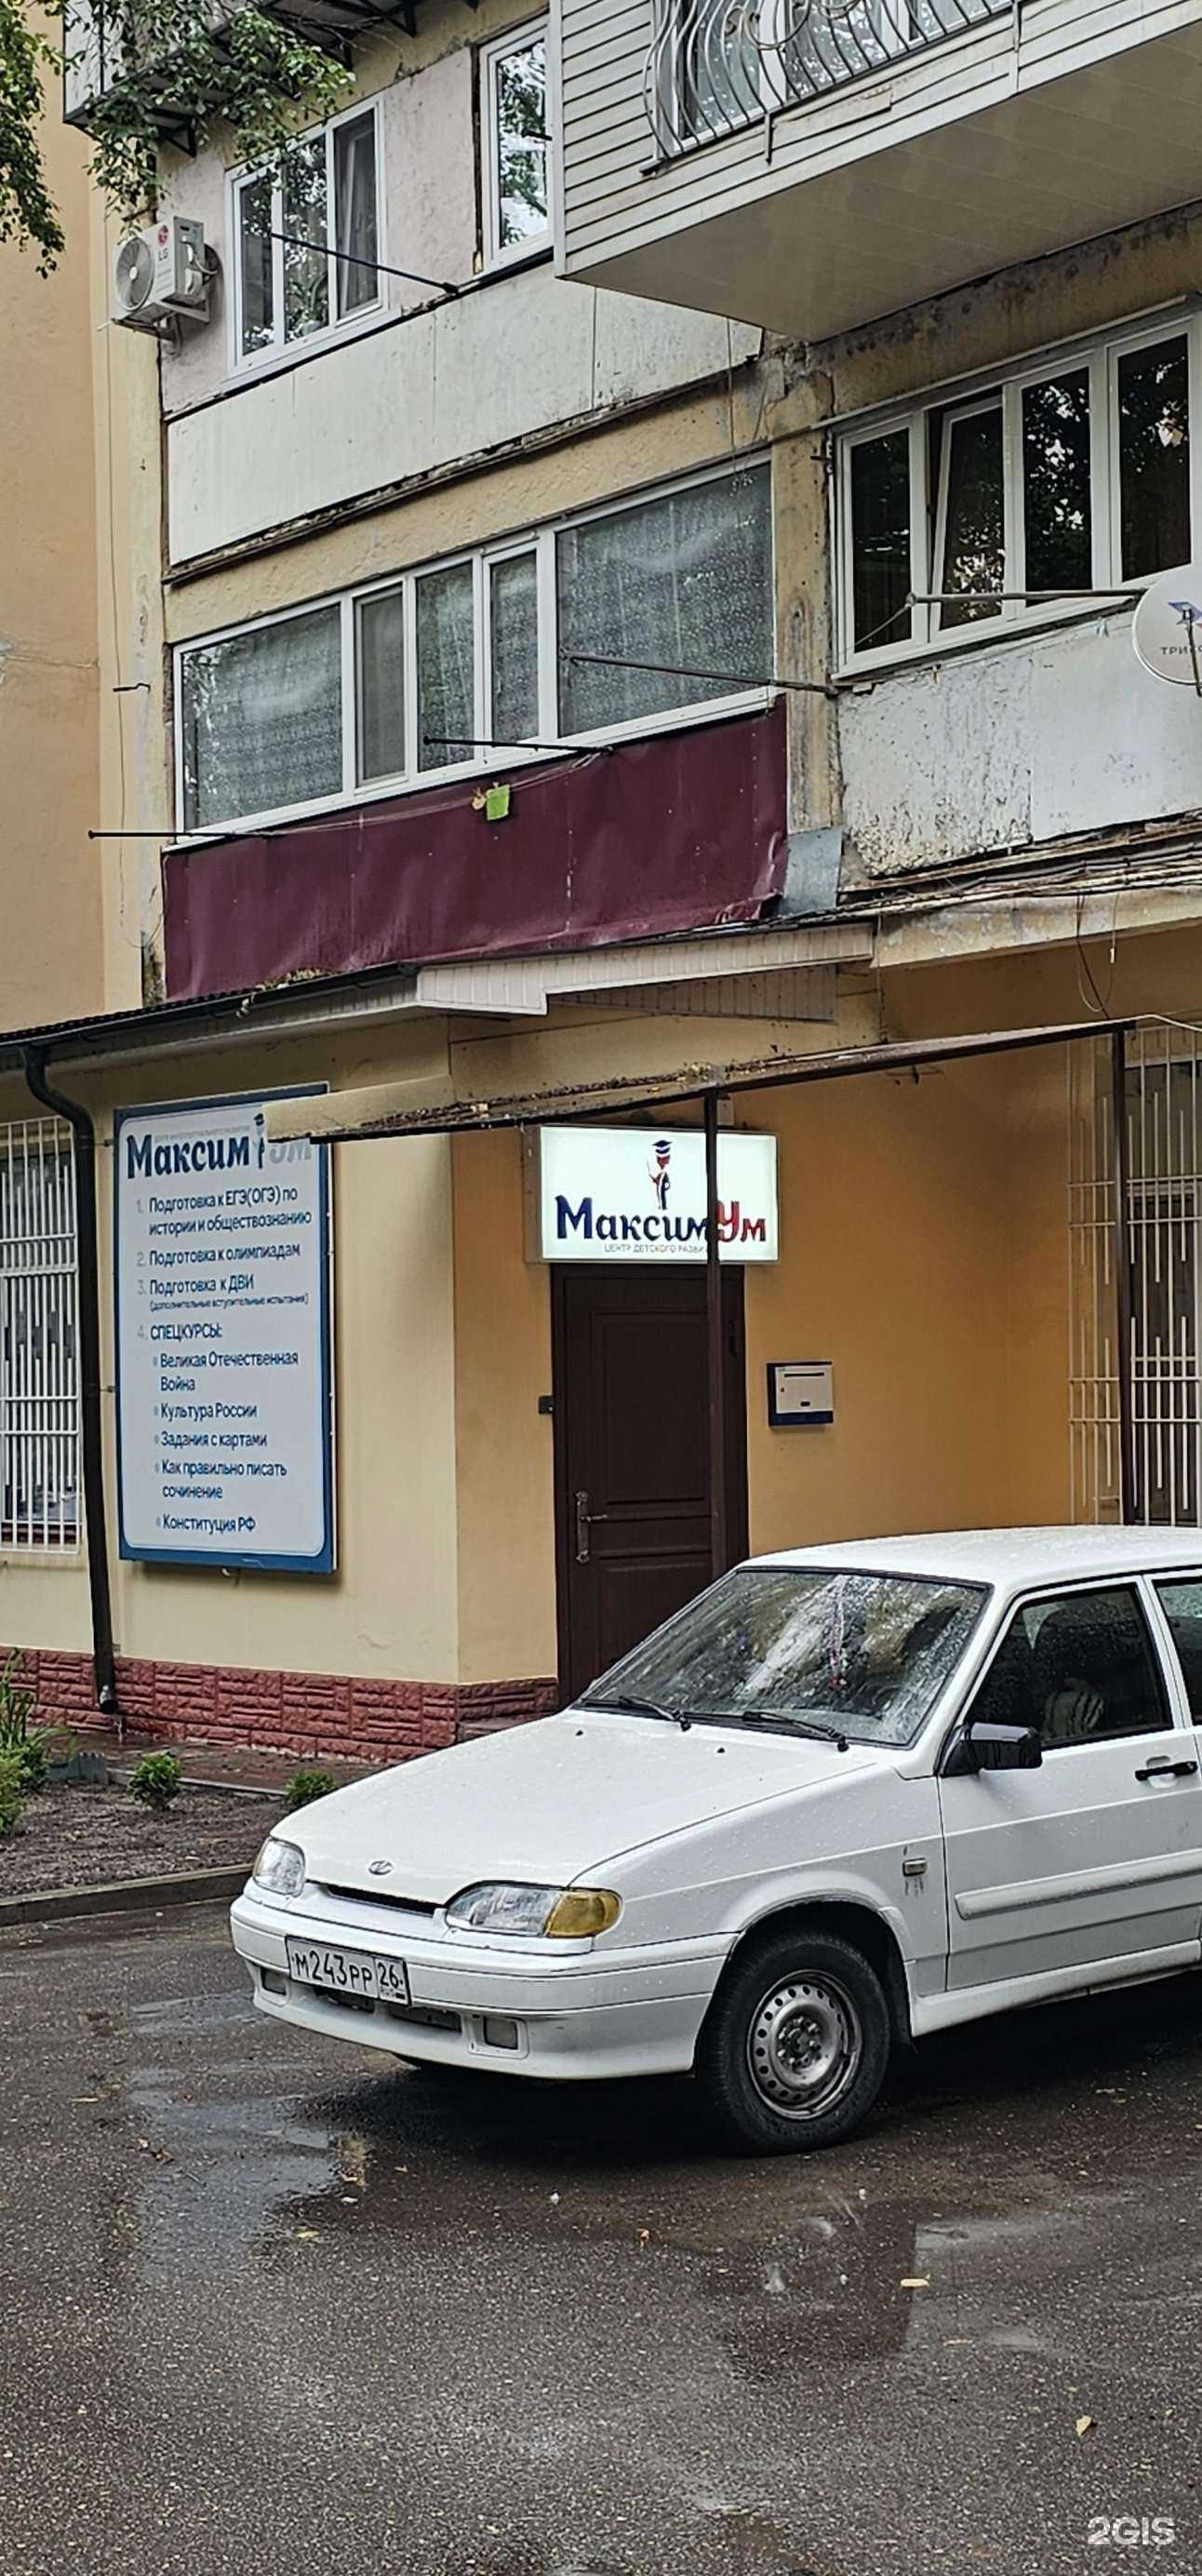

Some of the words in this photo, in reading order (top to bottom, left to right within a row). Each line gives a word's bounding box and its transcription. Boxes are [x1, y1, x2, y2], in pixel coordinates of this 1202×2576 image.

[158, 248, 169, 262] LG
[127, 1134, 249, 1179] Максим
[149, 1195, 216, 1214] Подготовка
[225, 1185, 281, 1208] ЕГЭ(ОГЭ)
[282, 1187, 299, 1201] по
[149, 1221, 195, 1238] истории
[207, 1211, 313, 1231] обществознанию
[149, 1250, 217, 1268] Подготовка
[218, 1249, 225, 1262] к
[226, 1242, 300, 1260] олимпиадам
[604, 1242, 631, 1254] ЦЕНТР
[633, 1243, 675, 1254] ДЕТСКОГО
[149, 1278, 217, 1296] Подготовка
[220, 1279, 227, 1291] к
[228, 1273, 255, 1294] ДВИ
[150, 1323, 223, 1342] СПЕЦКУРСЫ:
[160, 1352, 207, 1369] Великая
[207, 1349, 299, 1366] Отечественная
[160, 1375, 196, 1392] Война
[160, 1403, 215, 1423] Культура
[215, 1402, 258, 1418] России
[161, 1430, 210, 1448] Задания
[210, 1434, 219, 1446] с
[219, 1433, 268, 1450] картами
[161, 1459, 182, 1475] Как
[182, 1461, 246, 1478] правильно
[247, 1463, 287, 1477] писать
[162, 1485, 224, 1499] сочинение
[162, 1514, 237, 1536] Конституция
[237, 1516, 258, 1534] РФ
